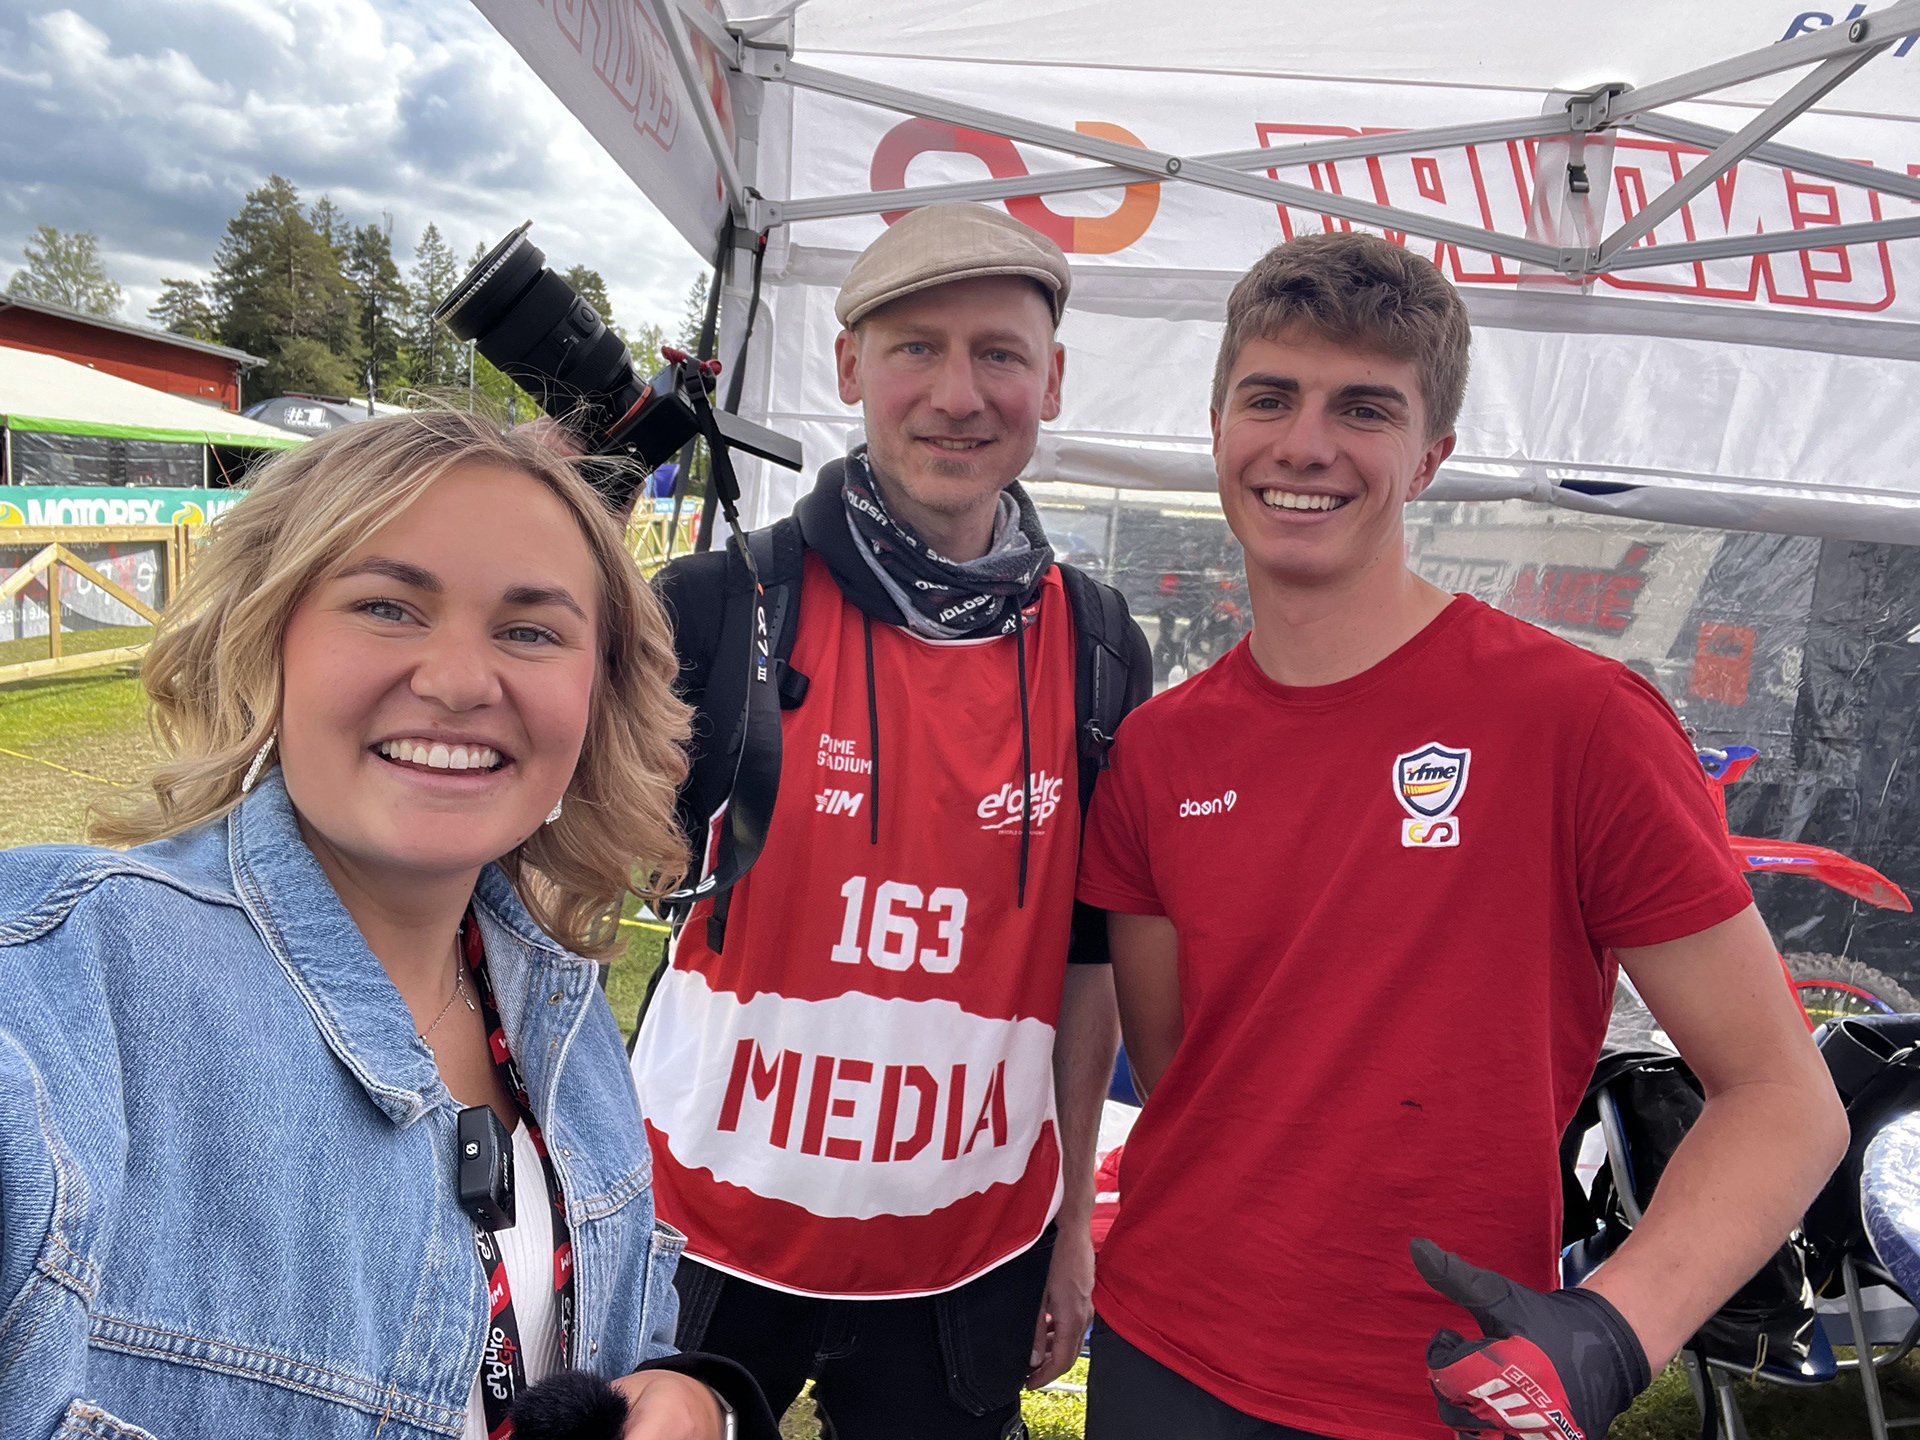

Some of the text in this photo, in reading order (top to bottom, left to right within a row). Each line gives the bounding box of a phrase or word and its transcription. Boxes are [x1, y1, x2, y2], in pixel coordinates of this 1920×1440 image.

[27, 497, 159, 525] MOTOREX
[831, 875, 968, 973] 163
[717, 1037, 1008, 1163] MEDIA
[485, 1327, 508, 1400] enduro
[1501, 1364, 1553, 1409] ERIC
